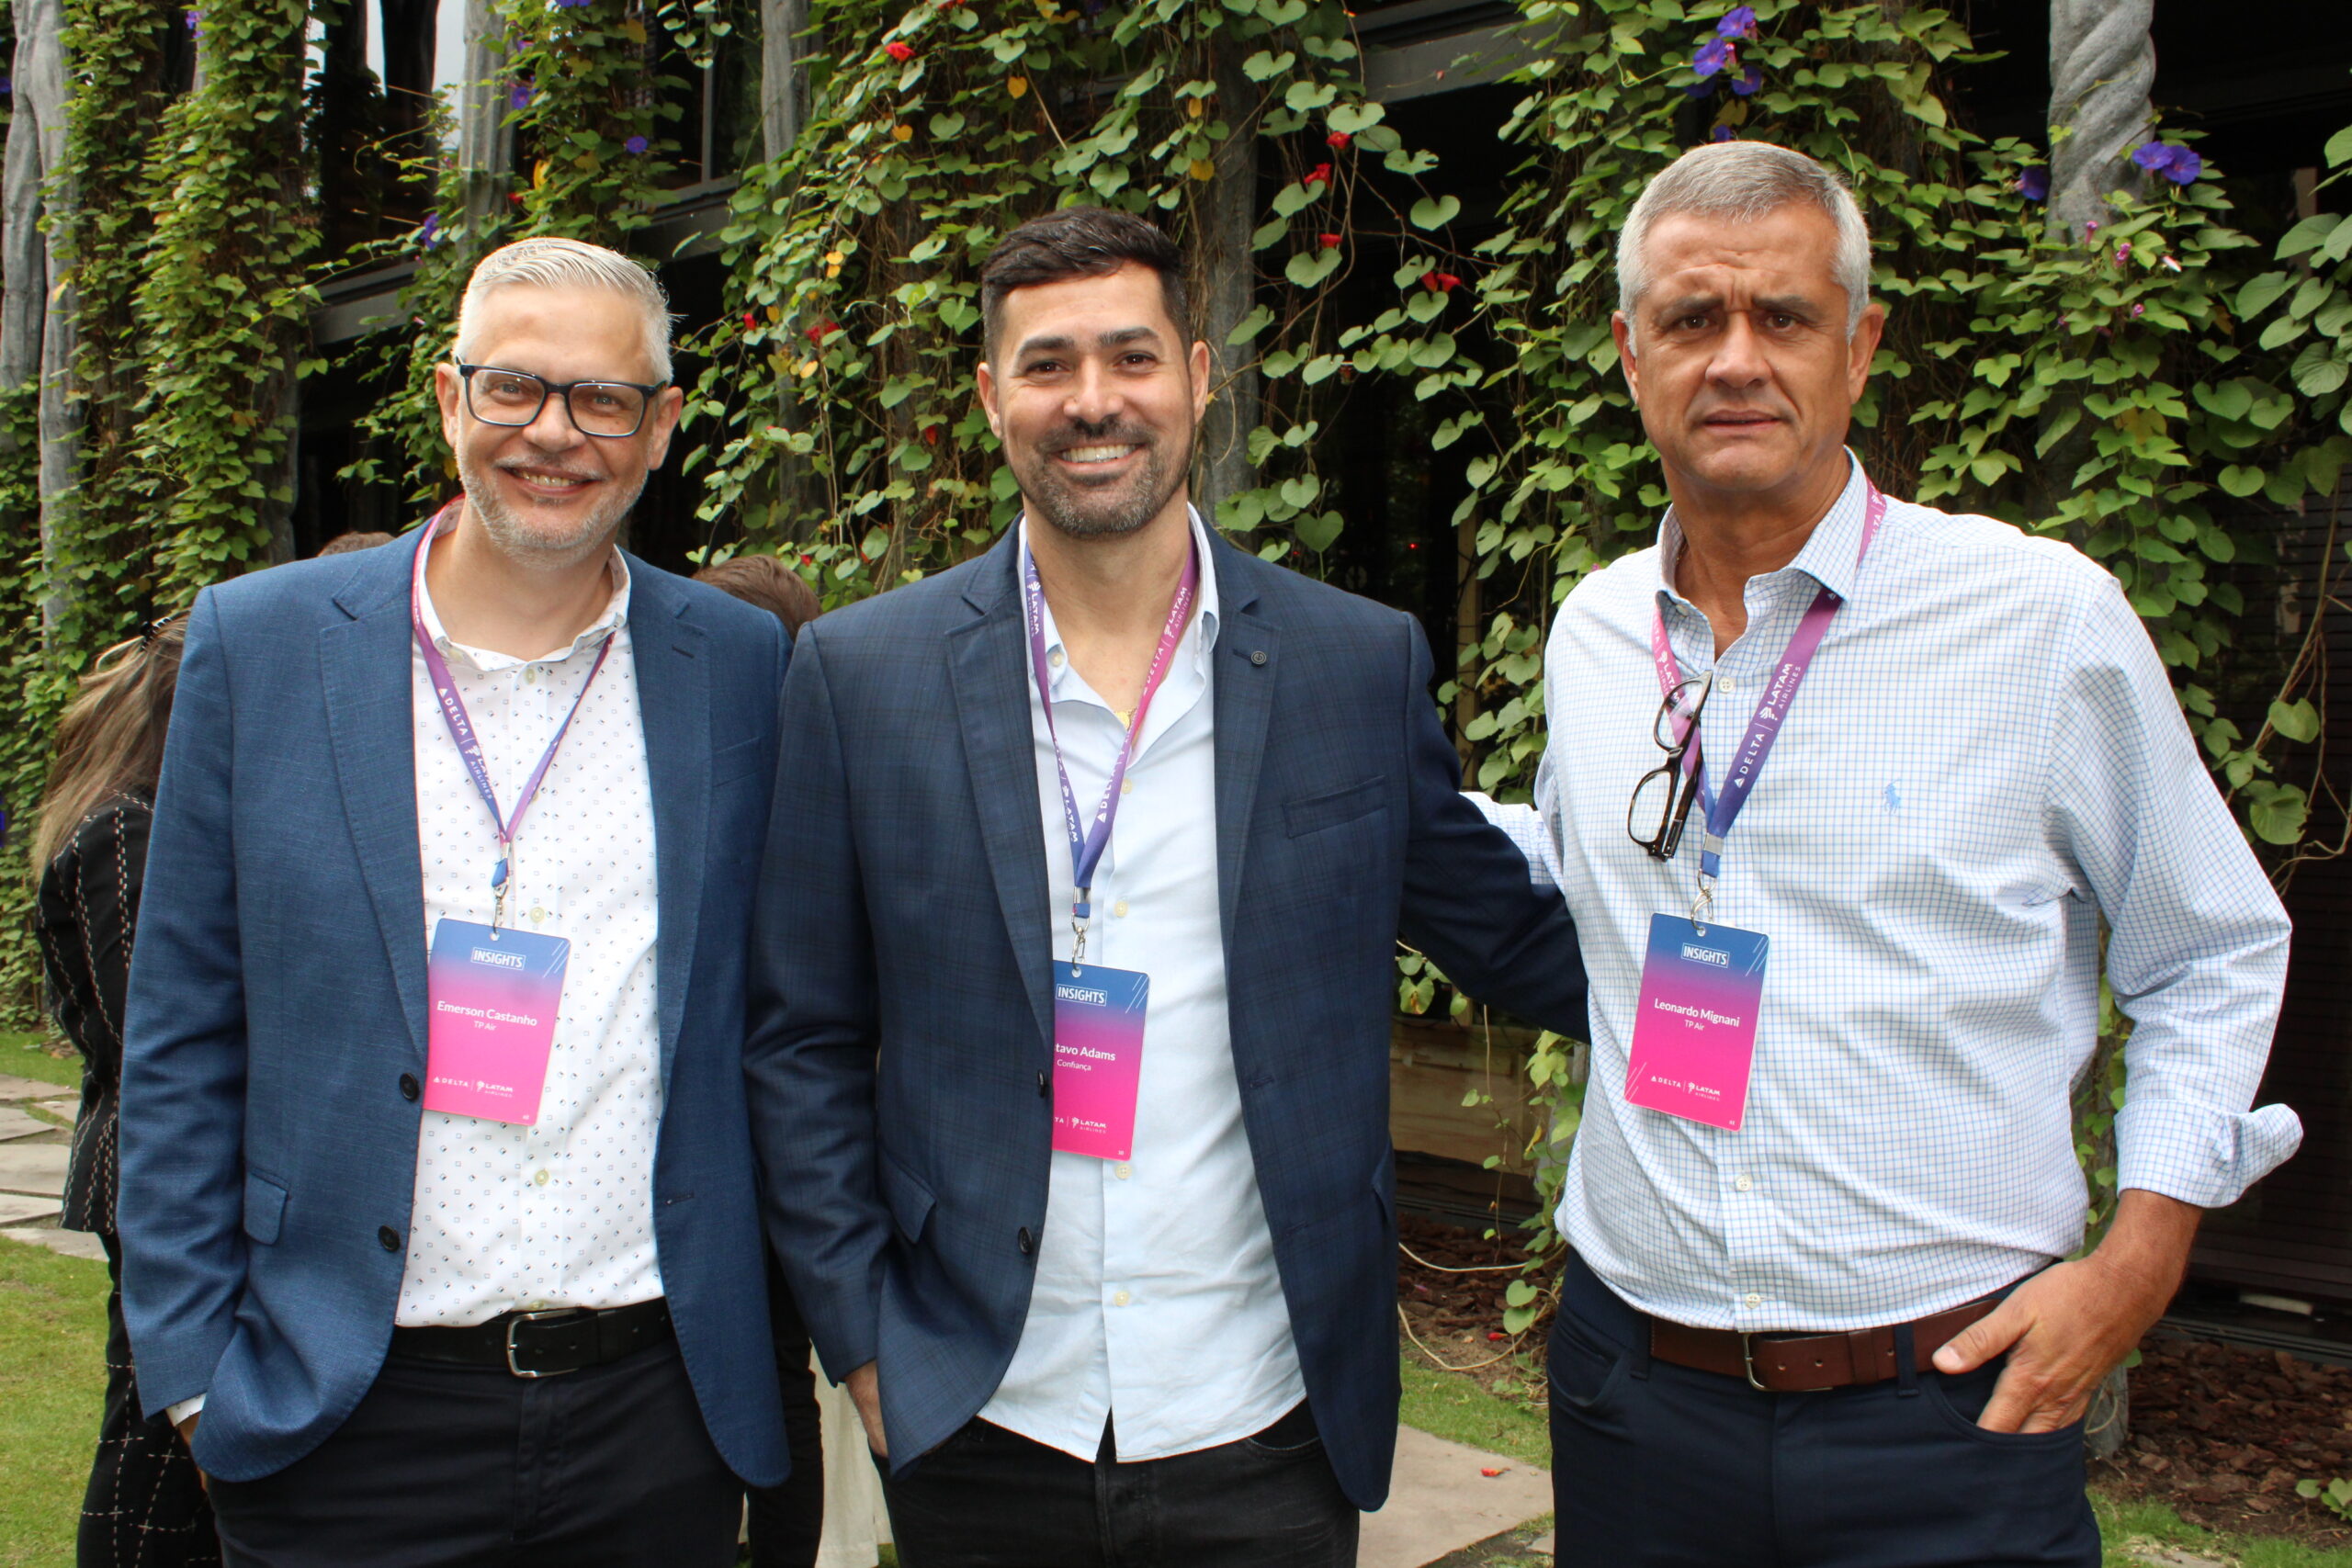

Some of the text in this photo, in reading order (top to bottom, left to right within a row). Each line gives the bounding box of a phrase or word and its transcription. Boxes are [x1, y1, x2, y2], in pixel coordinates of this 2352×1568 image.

[1031, 592, 1040, 635] LATAM
[1169, 587, 1188, 624] LATAM
[1778, 665, 1802, 709] AIRLINES
[445, 697, 469, 736] DELTA
[1739, 663, 1793, 775] DELTA LATAM
[469, 761, 493, 800] AIRLINES
[1065, 799, 1079, 842] LATAM
[473, 949, 524, 968] INSIGHTS
[1682, 945, 1727, 965] INSIGHTS
[1057, 986, 1105, 1004] INSIGHTS
[436, 1000, 537, 1027] Emerson Castanho
[1654, 998, 1740, 1028] Leonardo Mignani
[473, 1021, 497, 1032] TP Air
[1684, 1019, 1705, 1032] TP Air
[1055, 1043, 1116, 1061] tavo Adams
[1057, 1058, 1091, 1072] Confiança
[441, 1077, 514, 1093] DELTA LATAM
[1657, 1077, 1721, 1097] DELTA LATAM
[1080, 1119, 1106, 1129] LATAM
